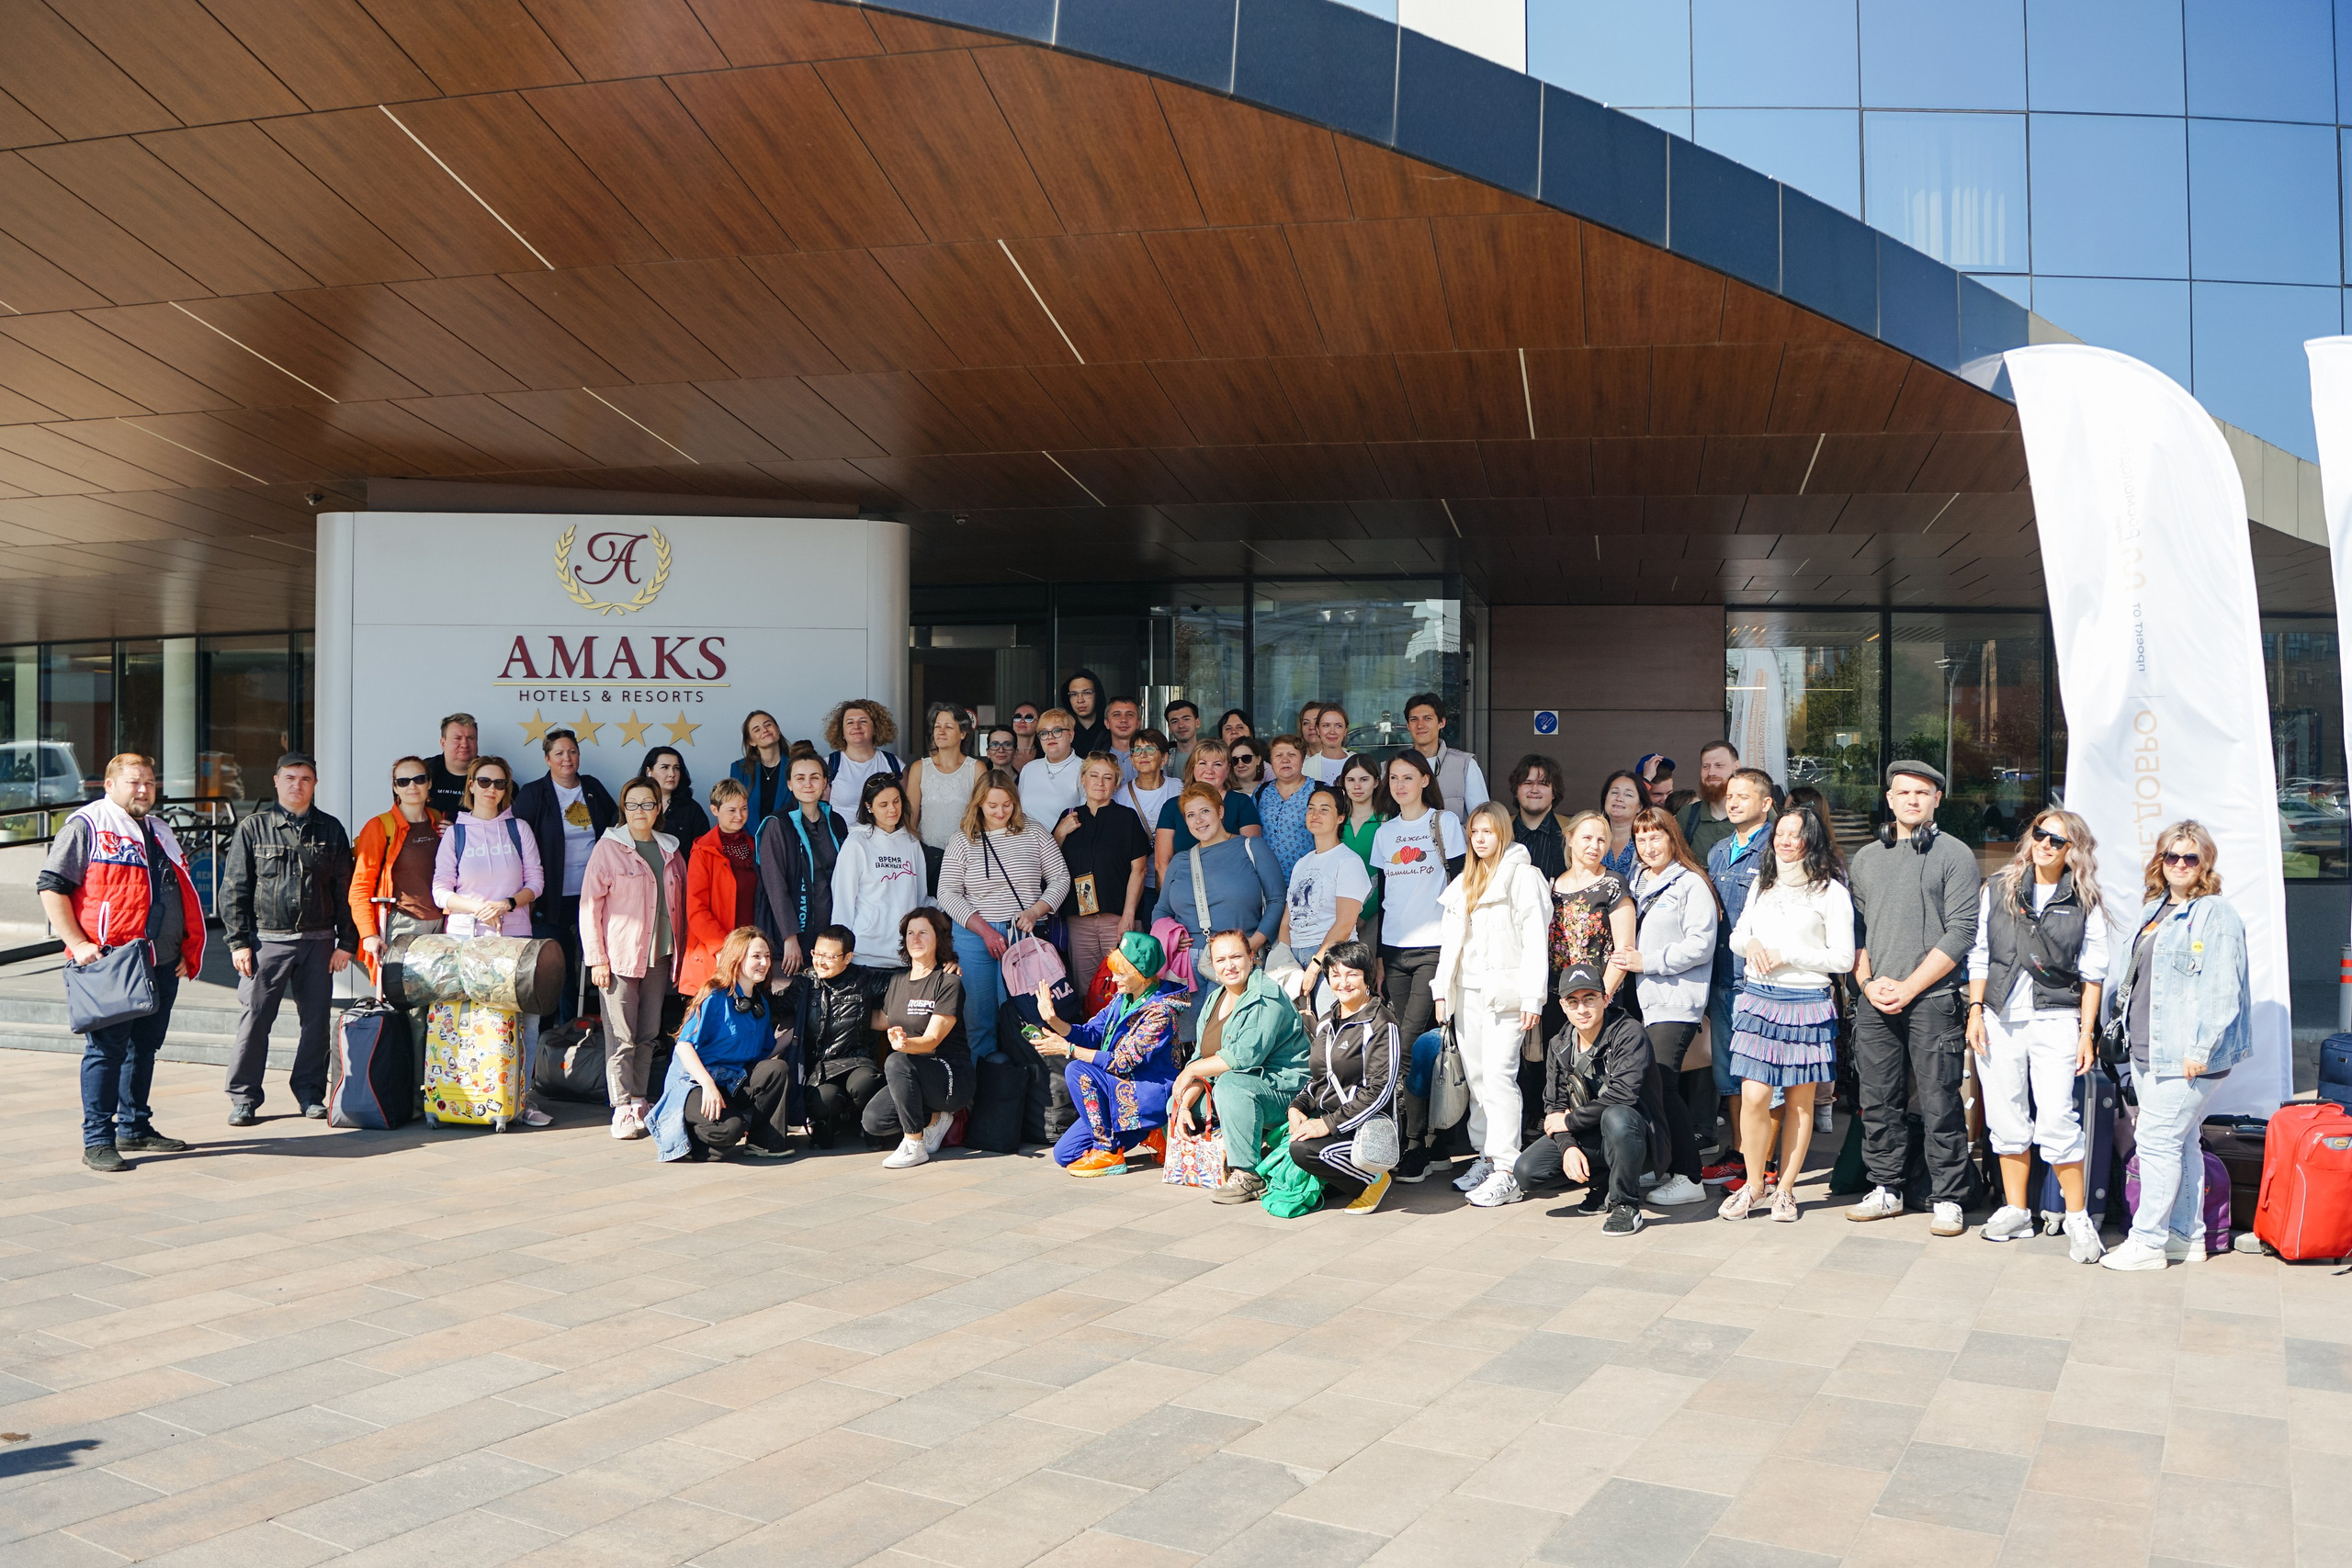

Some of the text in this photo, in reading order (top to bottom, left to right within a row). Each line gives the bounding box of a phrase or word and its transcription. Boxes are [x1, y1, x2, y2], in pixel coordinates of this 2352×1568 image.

[498, 636, 726, 680] AMAKS
[520, 690, 703, 702] HOTELS & RESORTS
[908, 998, 935, 1009] ДОБРО
